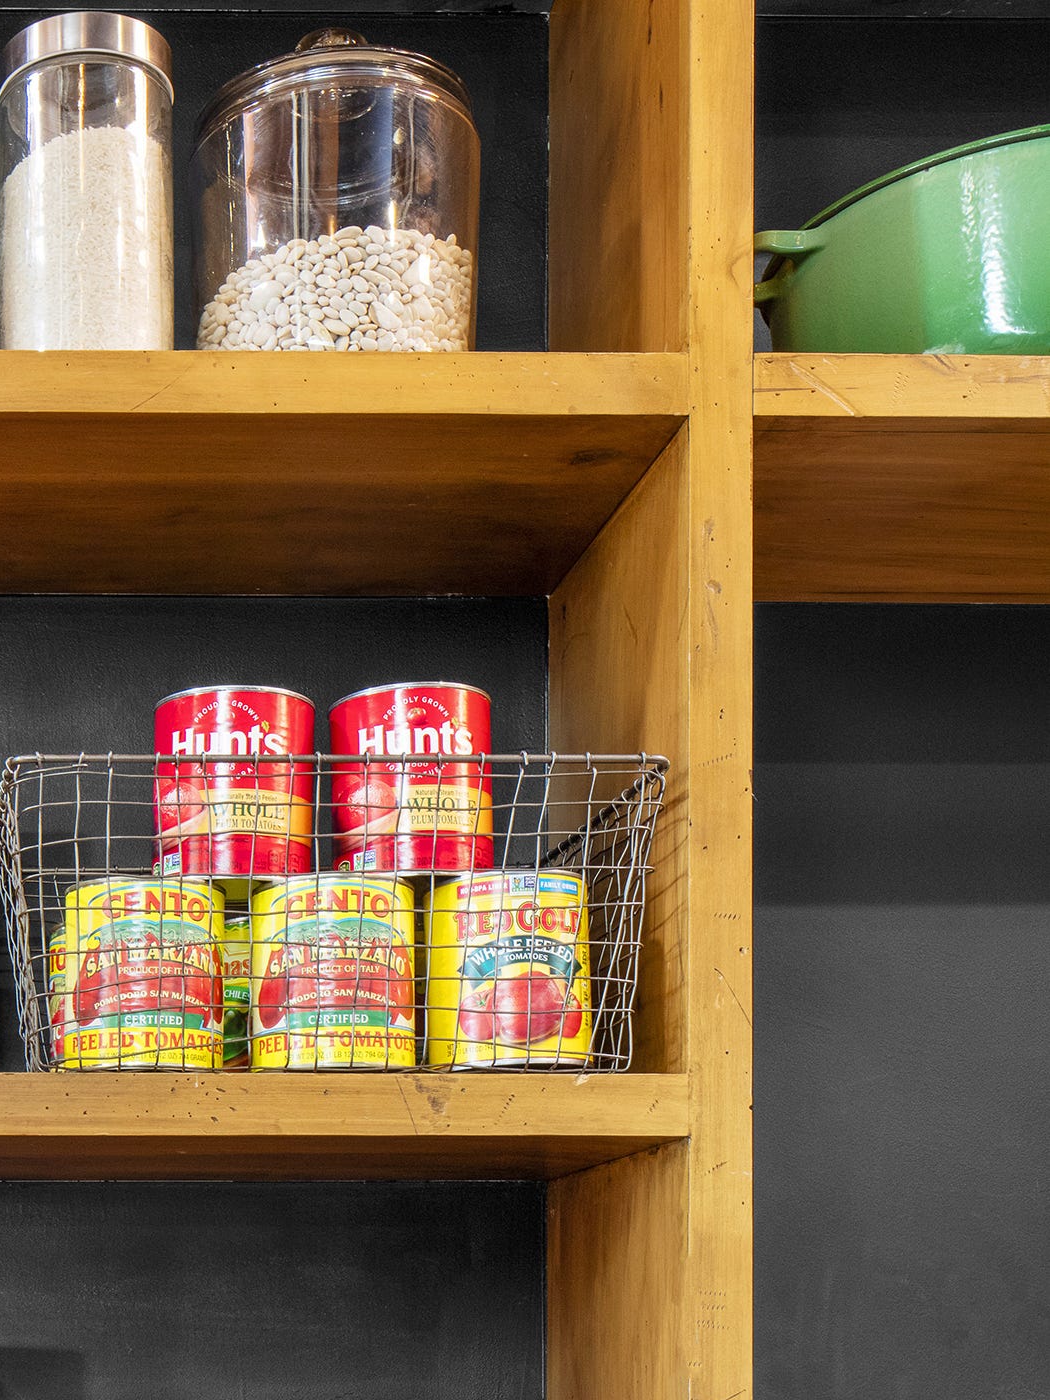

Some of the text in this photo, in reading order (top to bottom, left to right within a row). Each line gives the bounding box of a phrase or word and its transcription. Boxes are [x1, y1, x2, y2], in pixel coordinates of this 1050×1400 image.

[231, 700, 260, 721] GROWN
[383, 696, 449, 720] PRODLY GROWN
[211, 800, 285, 821] WHOLE
[405, 797, 477, 816] WHOLE
[411, 815, 433, 825] PLUM
[102, 890, 206, 921] CENTO
[284, 888, 391, 920] CENTO
[452, 900, 582, 942] RED GOLD
[86, 944, 123, 977] SAN
[269, 945, 305, 977] SAN
[504, 951, 549, 963] TOMATOES
[118, 966, 160, 976] PRODUCT
[162, 966, 172, 975] OF
[301, 965, 343, 975] PRODUCT
[344, 964, 357, 973] OF
[93, 990, 147, 1010] POMODORO
[150, 990, 169, 998] SAN
[333, 988, 353, 998] SAN
[124, 1014, 183, 1026] CERTIFIED
[308, 1013, 369, 1025] CERTIFIED
[72, 1031, 135, 1054] PEELED
[259, 1030, 316, 1057] PEELED
